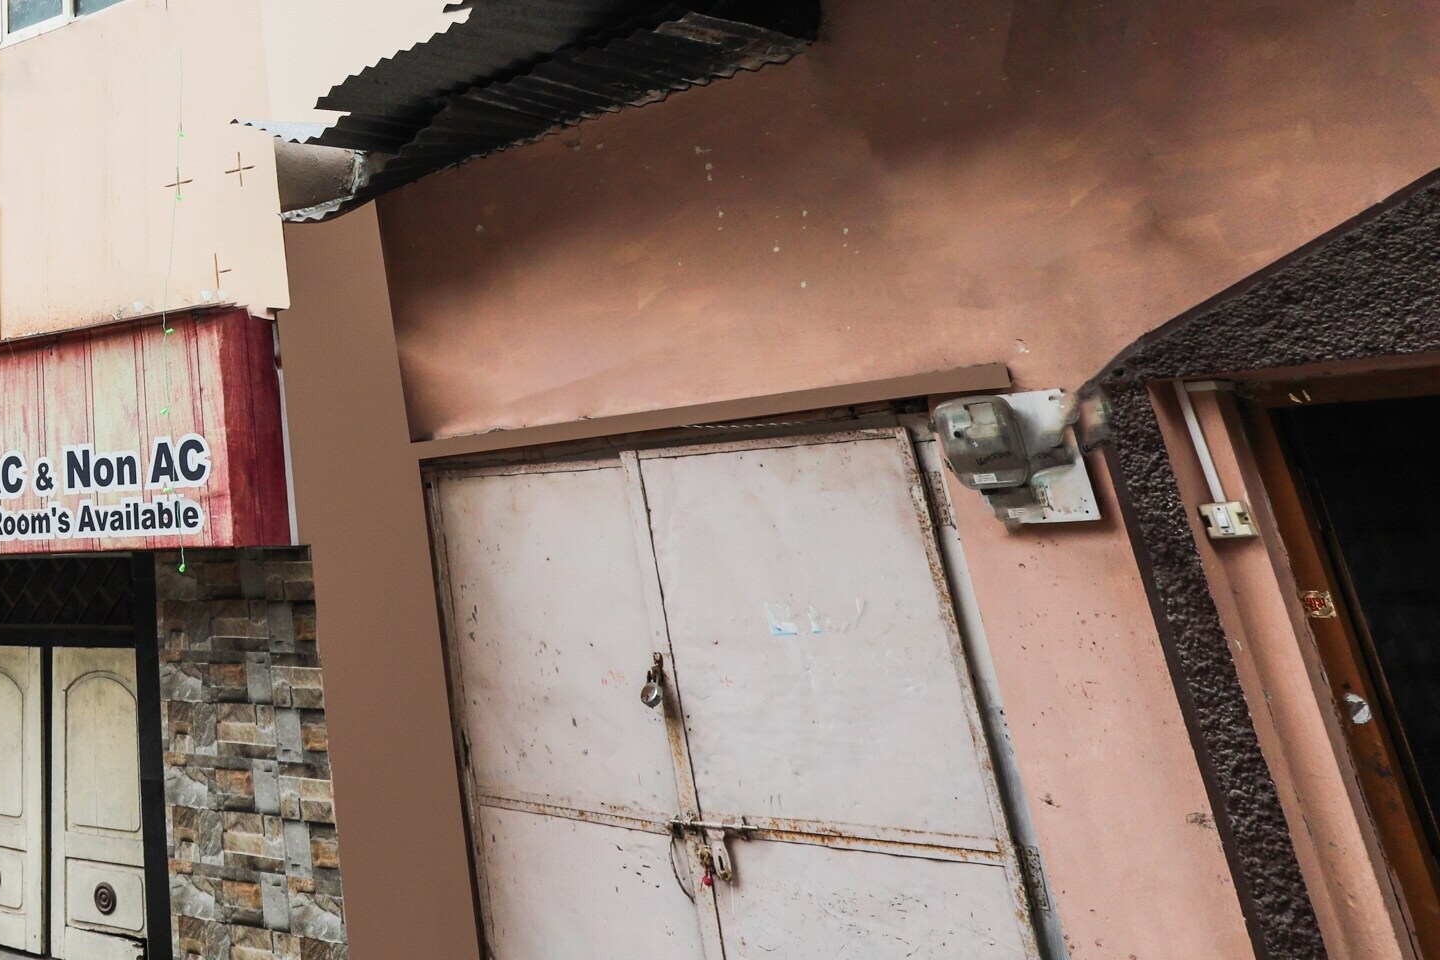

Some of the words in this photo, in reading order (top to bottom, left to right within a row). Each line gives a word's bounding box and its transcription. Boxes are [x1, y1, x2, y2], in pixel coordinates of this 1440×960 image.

[35, 462, 54, 491] &
[66, 449, 138, 489] Non
[151, 439, 207, 484] AC
[78, 500, 199, 533] Available
